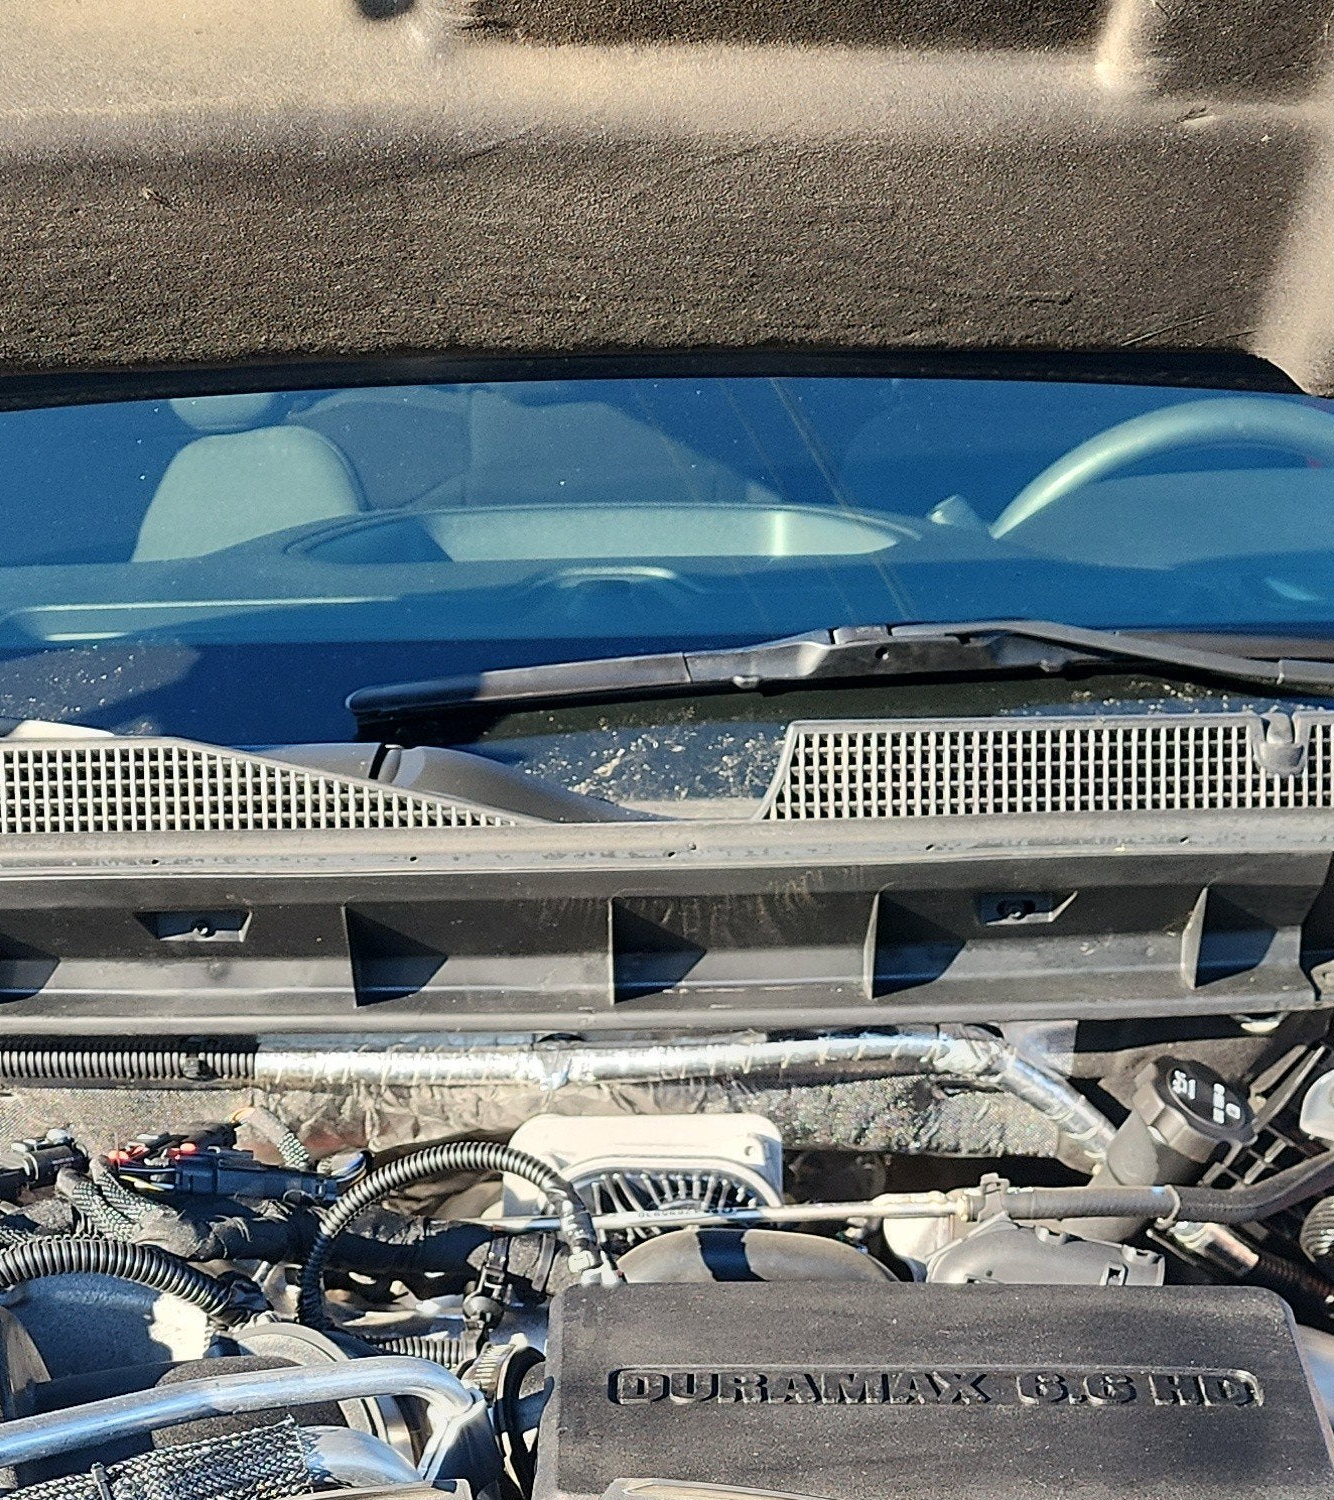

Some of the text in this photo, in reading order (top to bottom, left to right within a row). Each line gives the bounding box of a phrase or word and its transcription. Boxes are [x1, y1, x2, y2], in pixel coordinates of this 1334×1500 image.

[615, 1372, 1265, 1406] DURAMAX 6.6 HD
